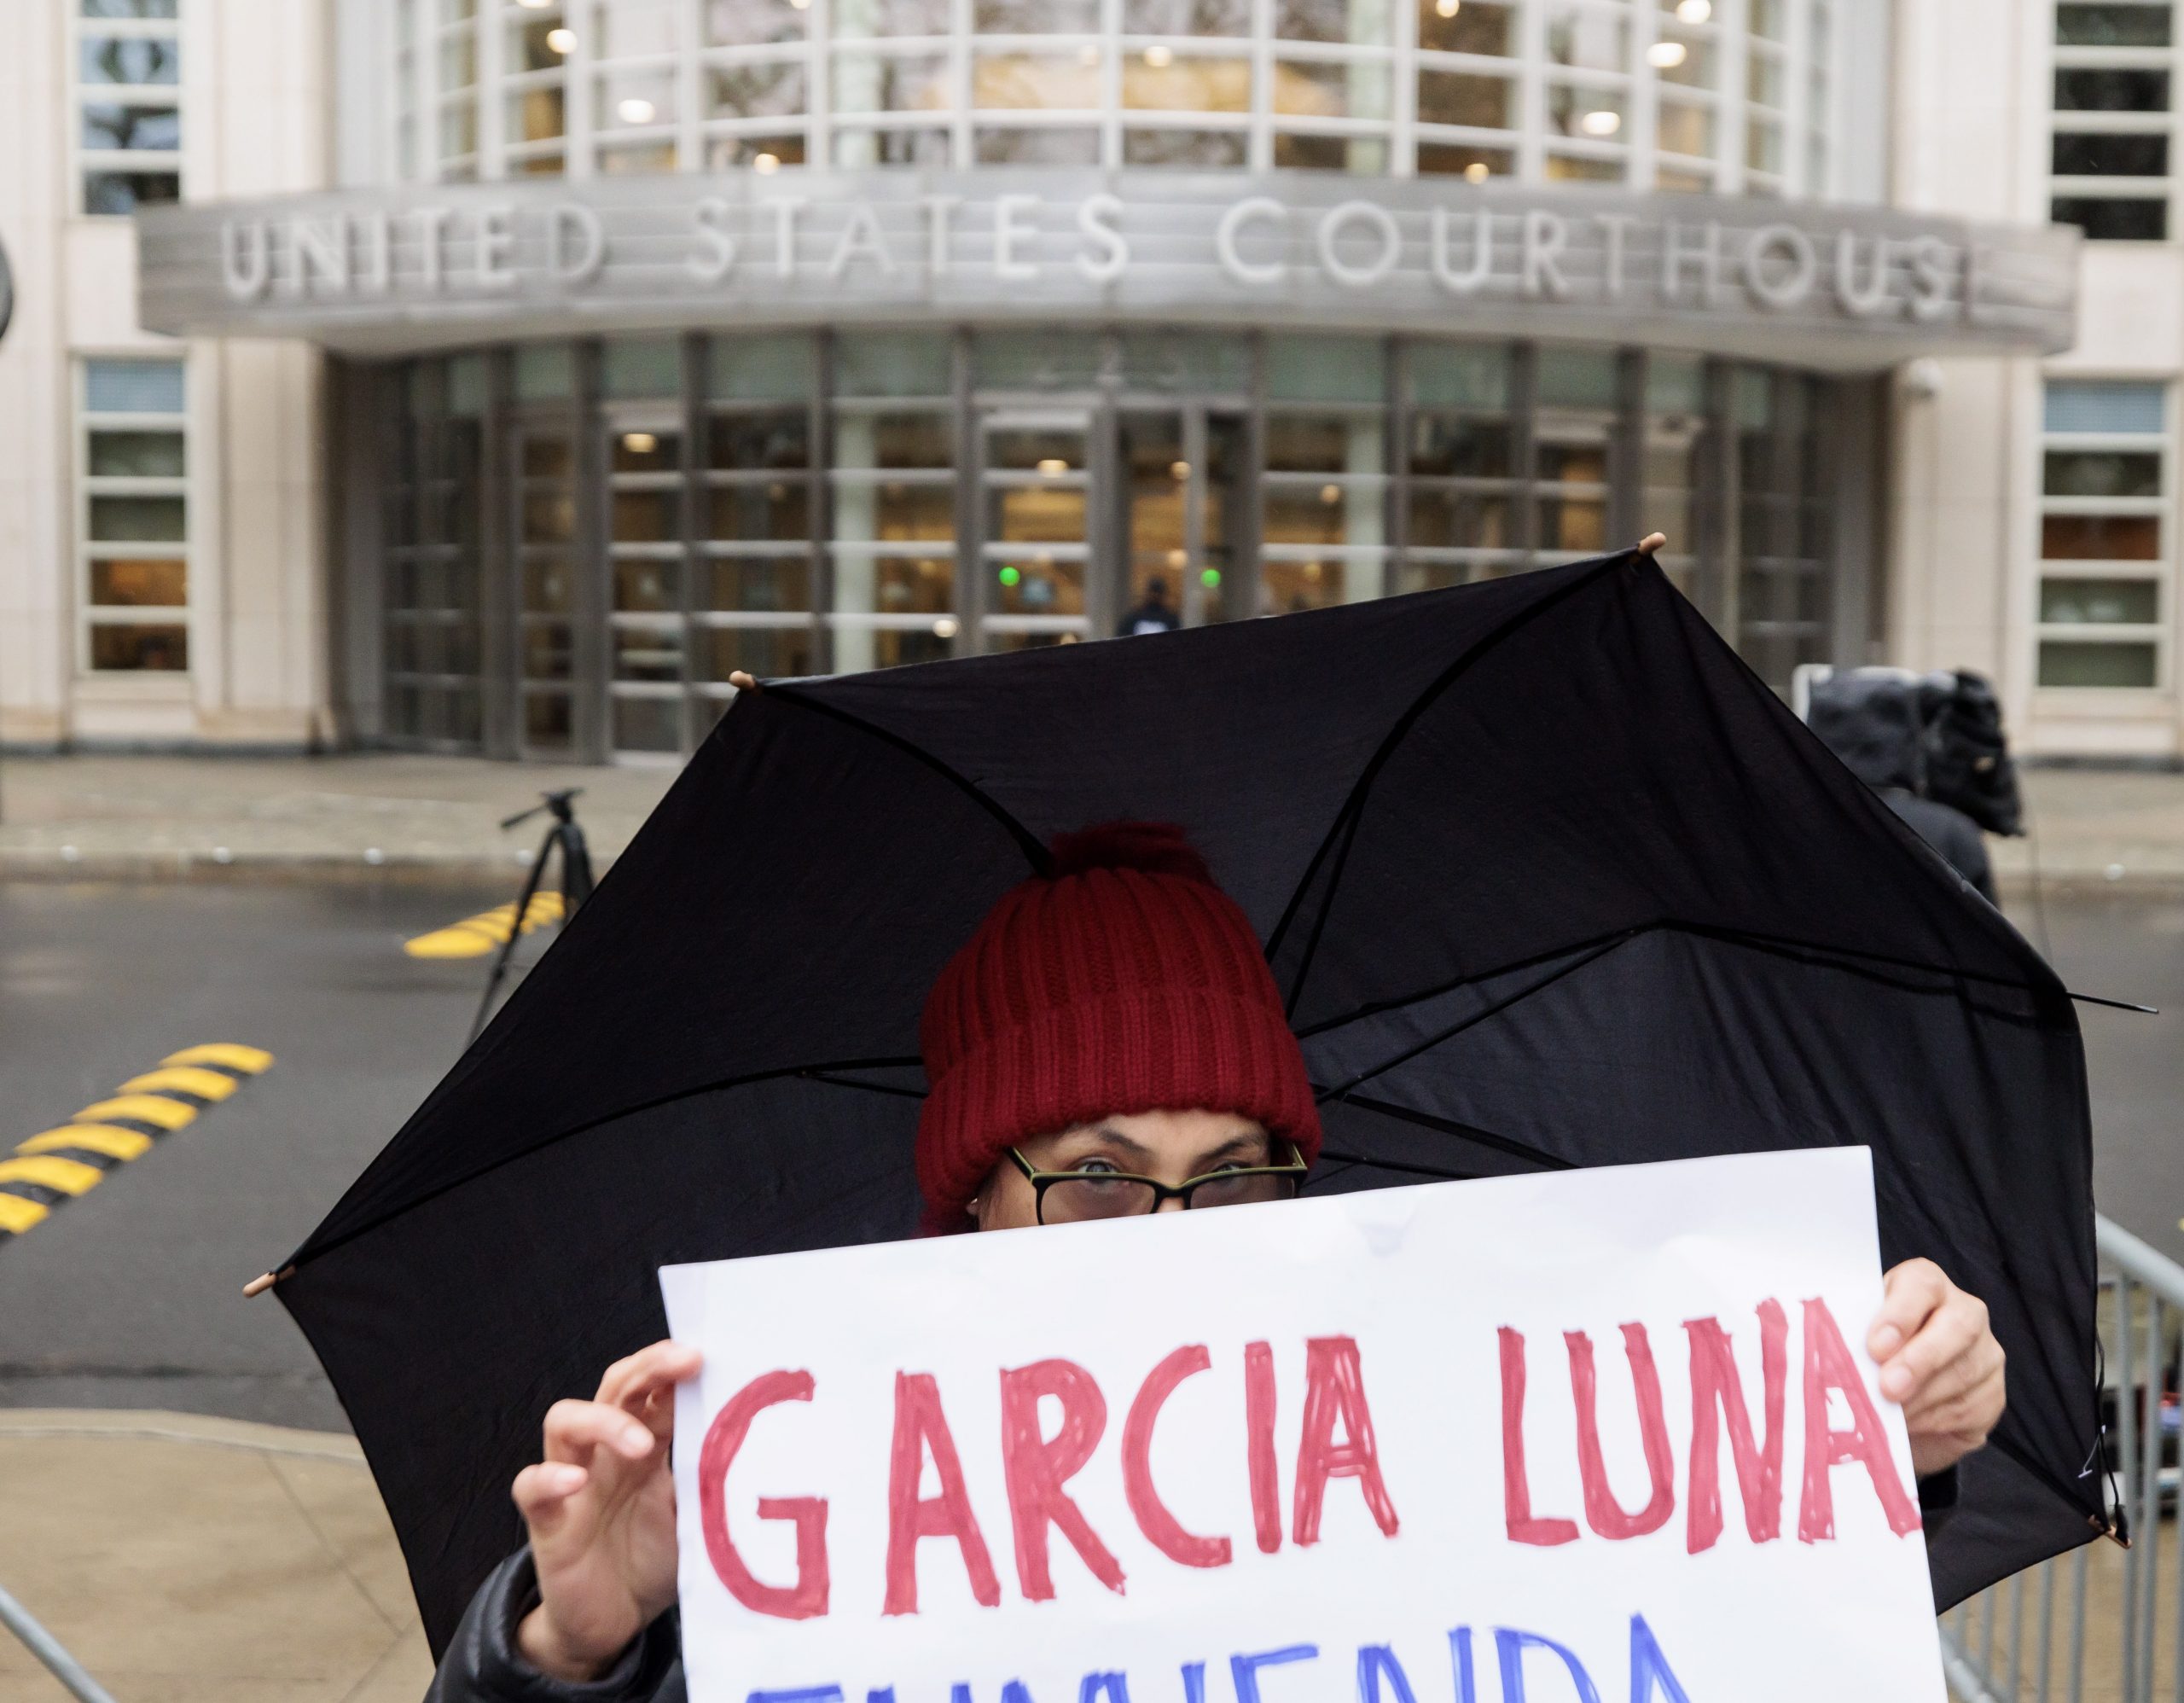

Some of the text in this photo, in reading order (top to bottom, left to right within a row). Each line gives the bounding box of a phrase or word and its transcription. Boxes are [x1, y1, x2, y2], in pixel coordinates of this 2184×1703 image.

[222, 193, 1971, 319] UNITED STATES COURTHOUS
[699, 1296, 1923, 1621] GARCIA LUNA
